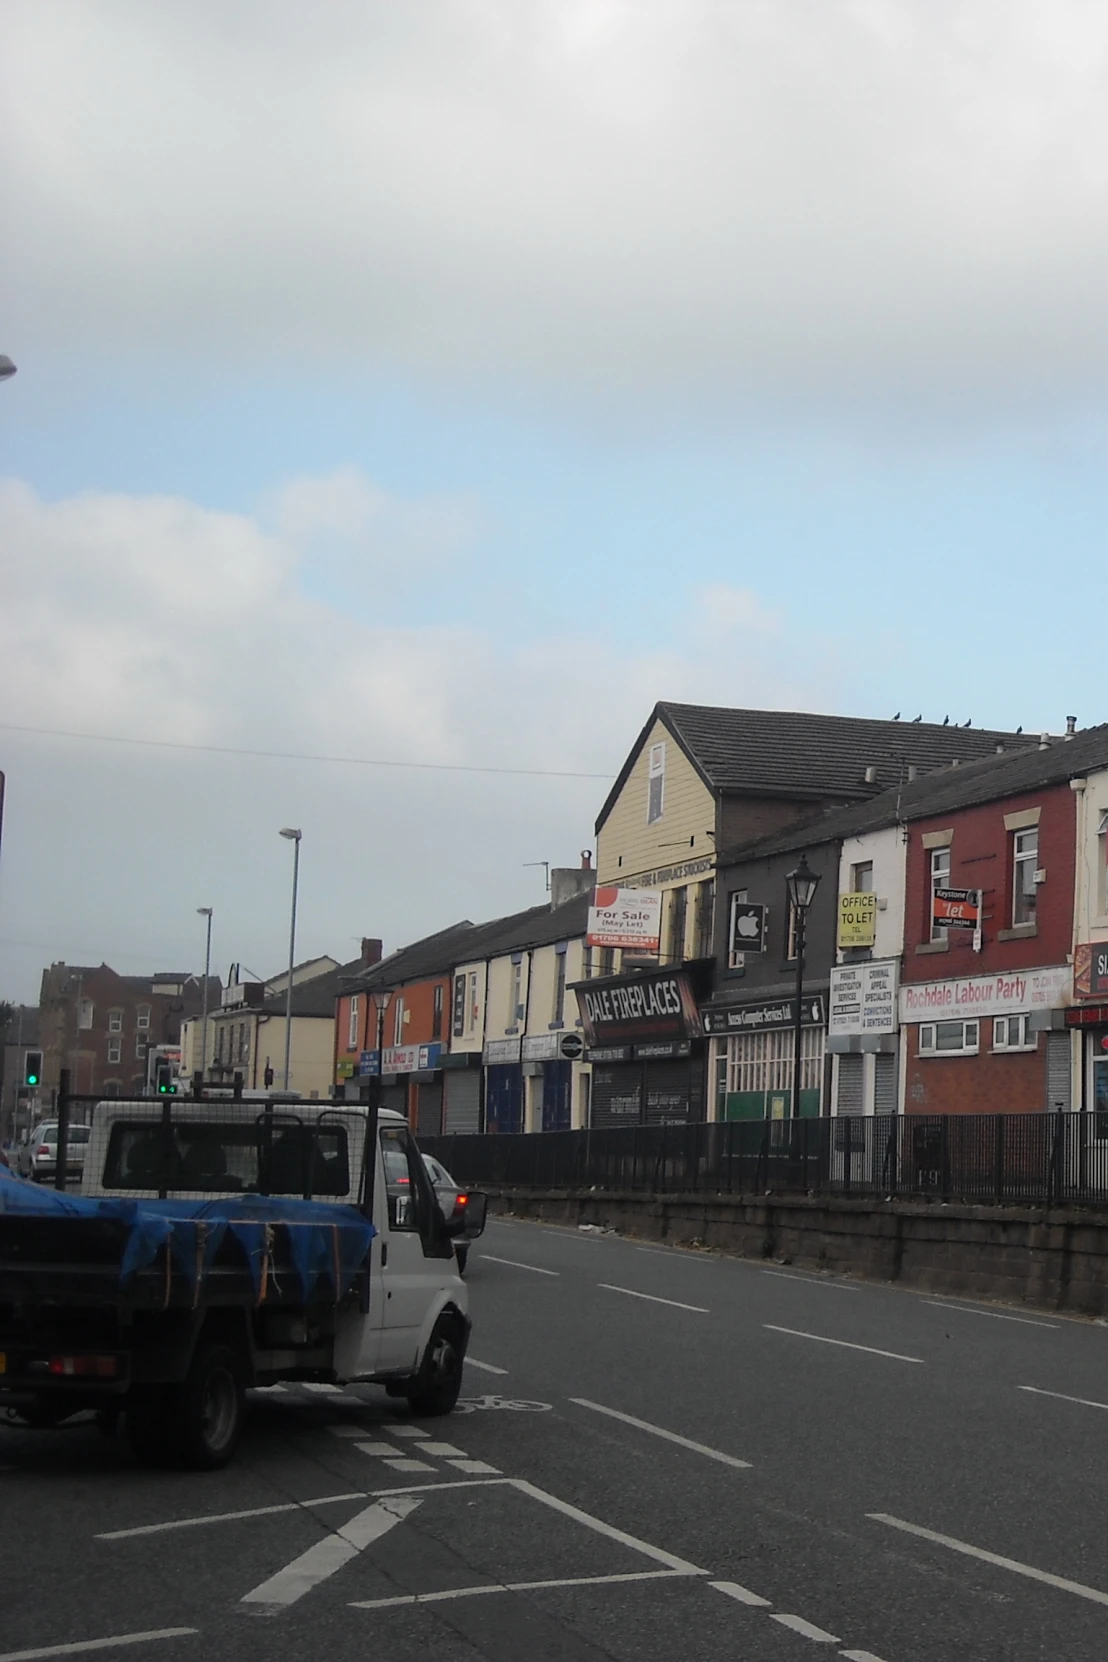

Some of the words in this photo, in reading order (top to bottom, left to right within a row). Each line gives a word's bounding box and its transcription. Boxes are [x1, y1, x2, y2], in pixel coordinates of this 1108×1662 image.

[936, 889, 966, 899] Keystone
[842, 896, 874, 908] OFFICE
[596, 909, 618, 918] For
[622, 911, 650, 920] Sale
[946, 902, 964, 918] let
[602, 919, 624, 927] (May
[841, 913, 854, 924] TO
[856, 912, 873, 923] LET
[906, 984, 952, 1008] Rochdale
[954, 982, 993, 1004] Labour
[996, 976, 1026, 1003] Party
[585, 990, 613, 1022] DALE
[610, 980, 681, 1020] FIREPLACES
